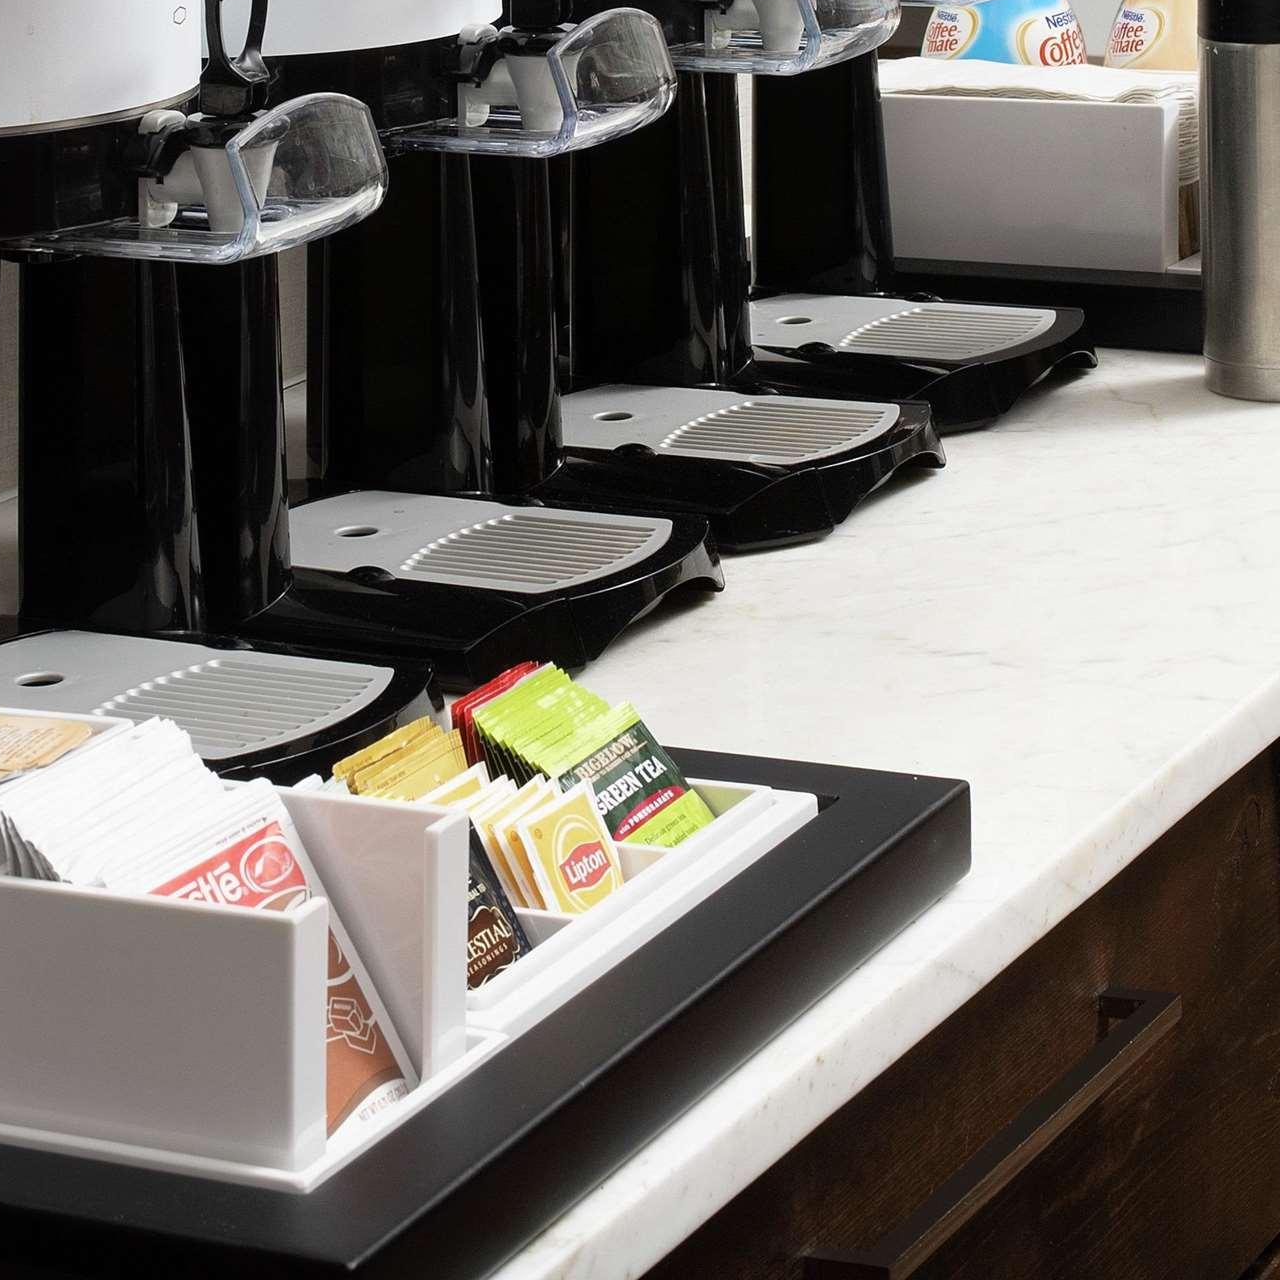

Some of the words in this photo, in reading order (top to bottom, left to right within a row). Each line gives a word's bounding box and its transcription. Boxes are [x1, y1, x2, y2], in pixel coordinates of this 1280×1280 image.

[926, 36, 959, 53] mate
[1112, 38, 1145, 54] mate
[573, 732, 638, 780] BIGELOW
[634, 755, 668, 784] TEA
[565, 849, 608, 885] Lipton
[467, 919, 512, 962] ESTIAL
